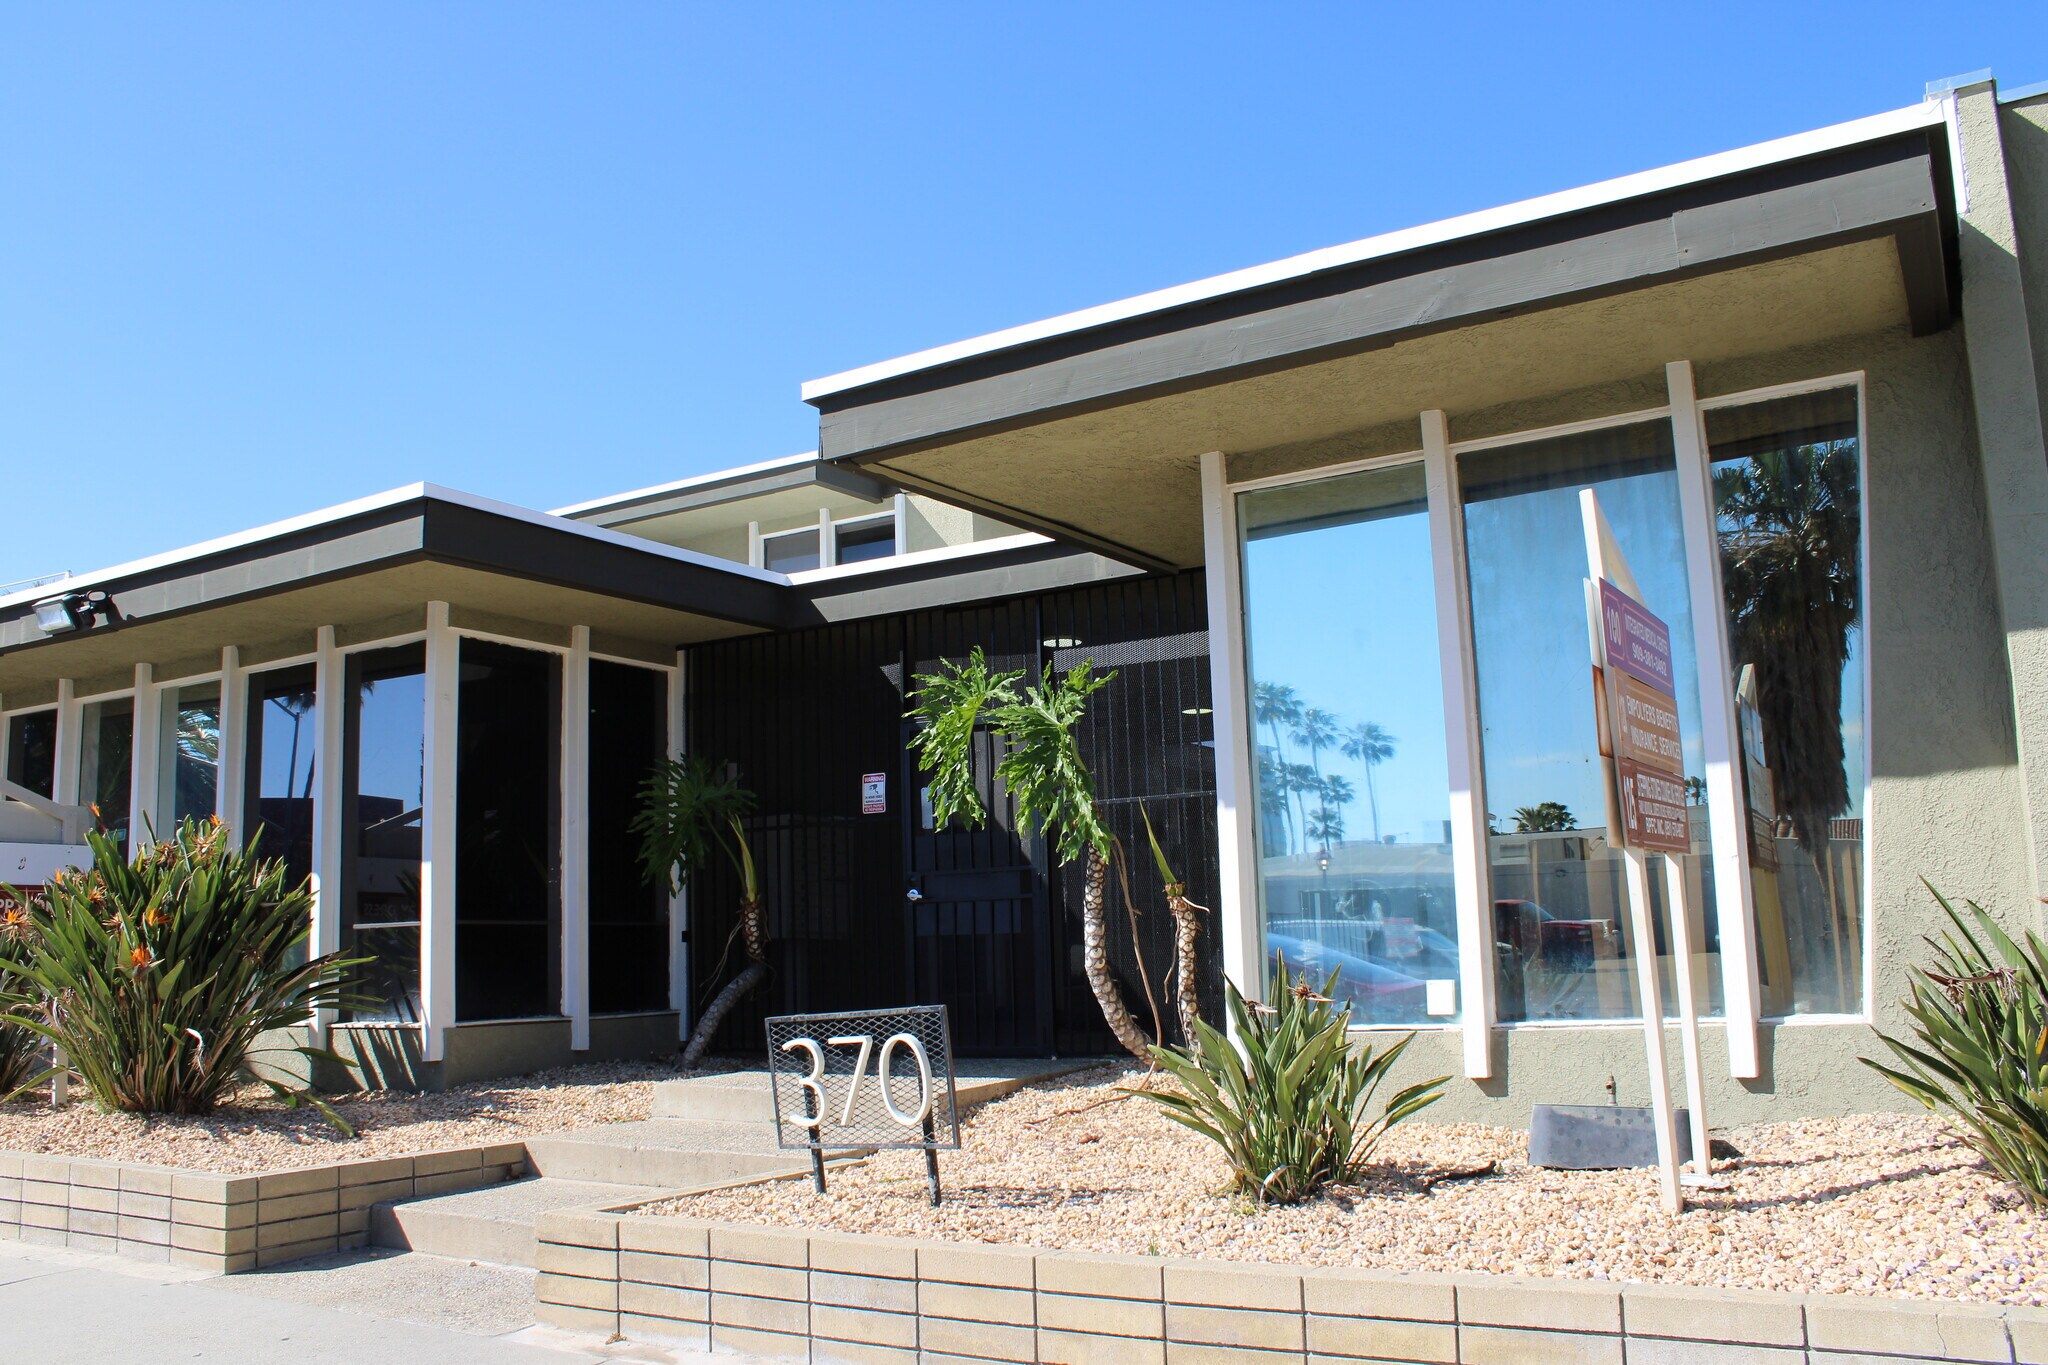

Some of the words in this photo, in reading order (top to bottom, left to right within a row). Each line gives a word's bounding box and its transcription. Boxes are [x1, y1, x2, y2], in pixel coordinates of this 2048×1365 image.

[1607, 606, 1622, 646] 100
[1656, 708, 1678, 733] BENEFITS
[1630, 725, 1659, 753] INSURANCE
[1659, 736, 1681, 760] SERVICES
[1624, 775, 1638, 831] 125
[782, 1033, 933, 1127] 370
